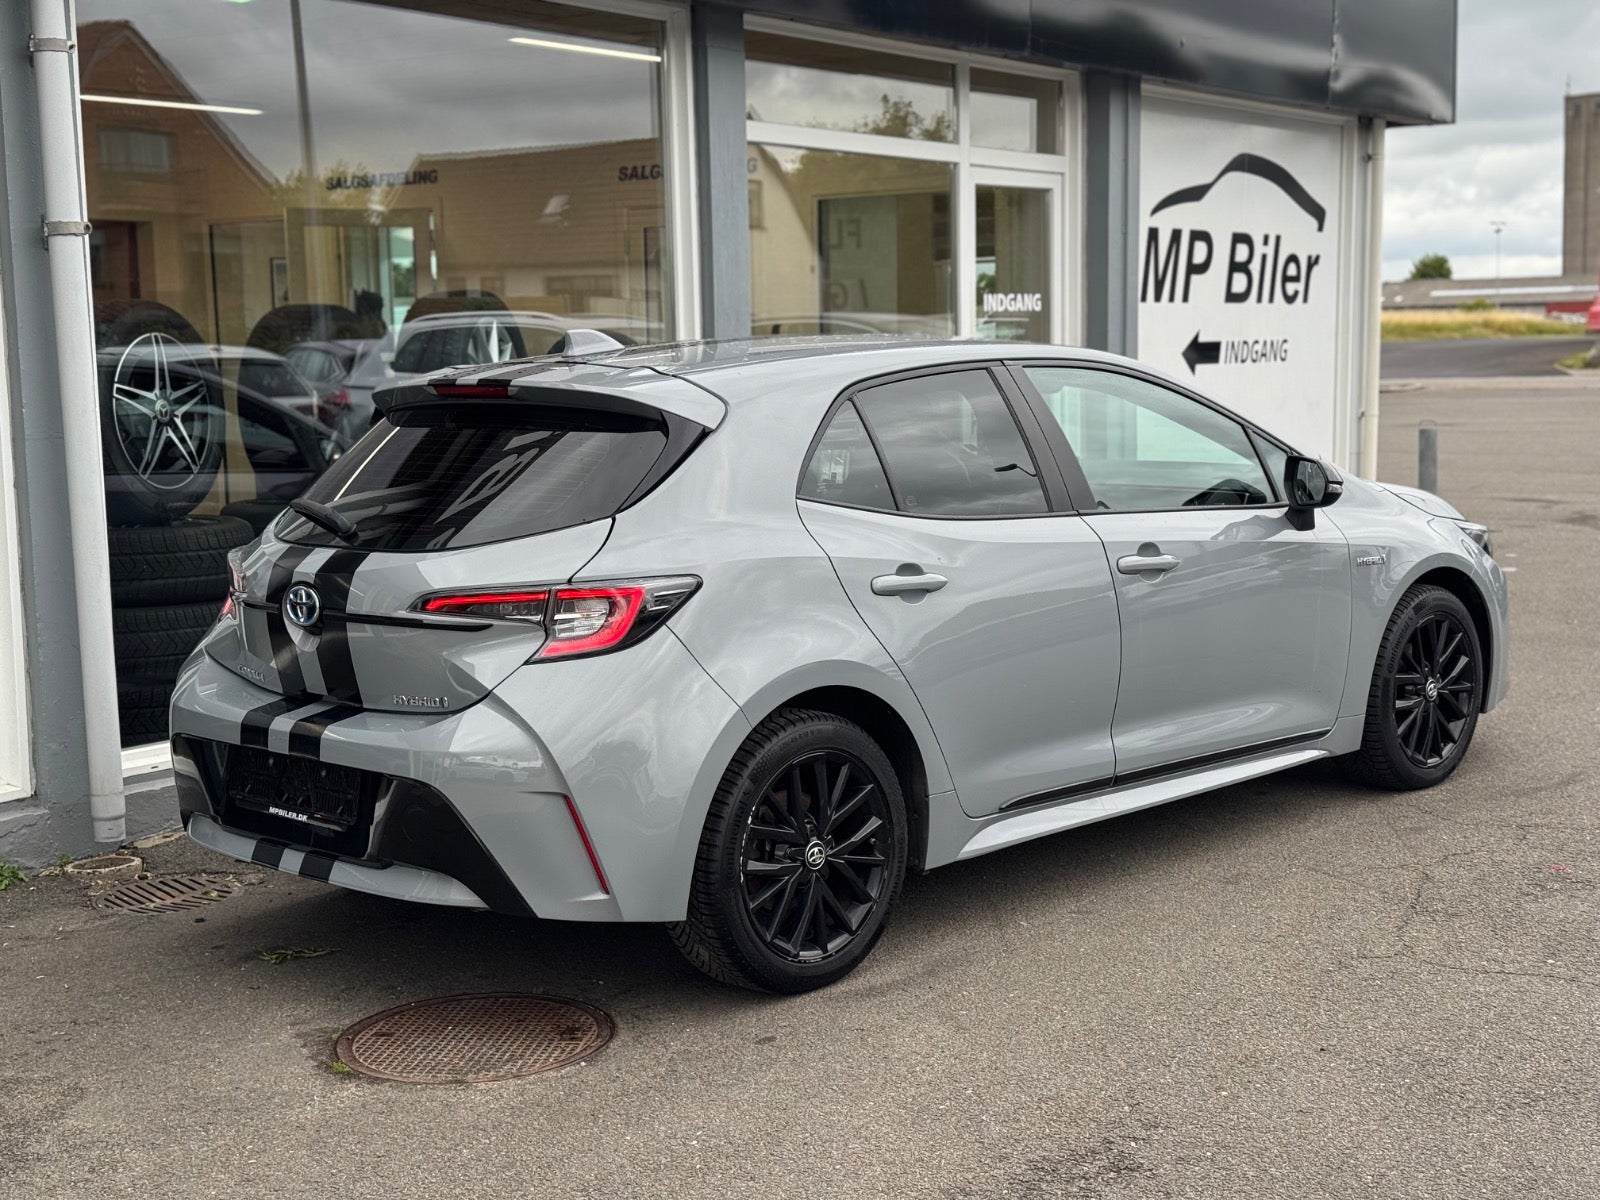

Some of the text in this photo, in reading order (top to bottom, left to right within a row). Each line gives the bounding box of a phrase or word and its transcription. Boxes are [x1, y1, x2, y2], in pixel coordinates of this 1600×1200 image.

[325, 169, 439, 191] SALGSAFDELING
[617, 164, 663, 182] SALG
[1140, 227, 1320, 305] MP Biler
[983, 293, 1042, 312] INDGANG
[1224, 339, 1288, 364] INDGANG
[393, 694, 440, 708] HYBRID
[269, 806, 309, 822] MPBILER.DK
